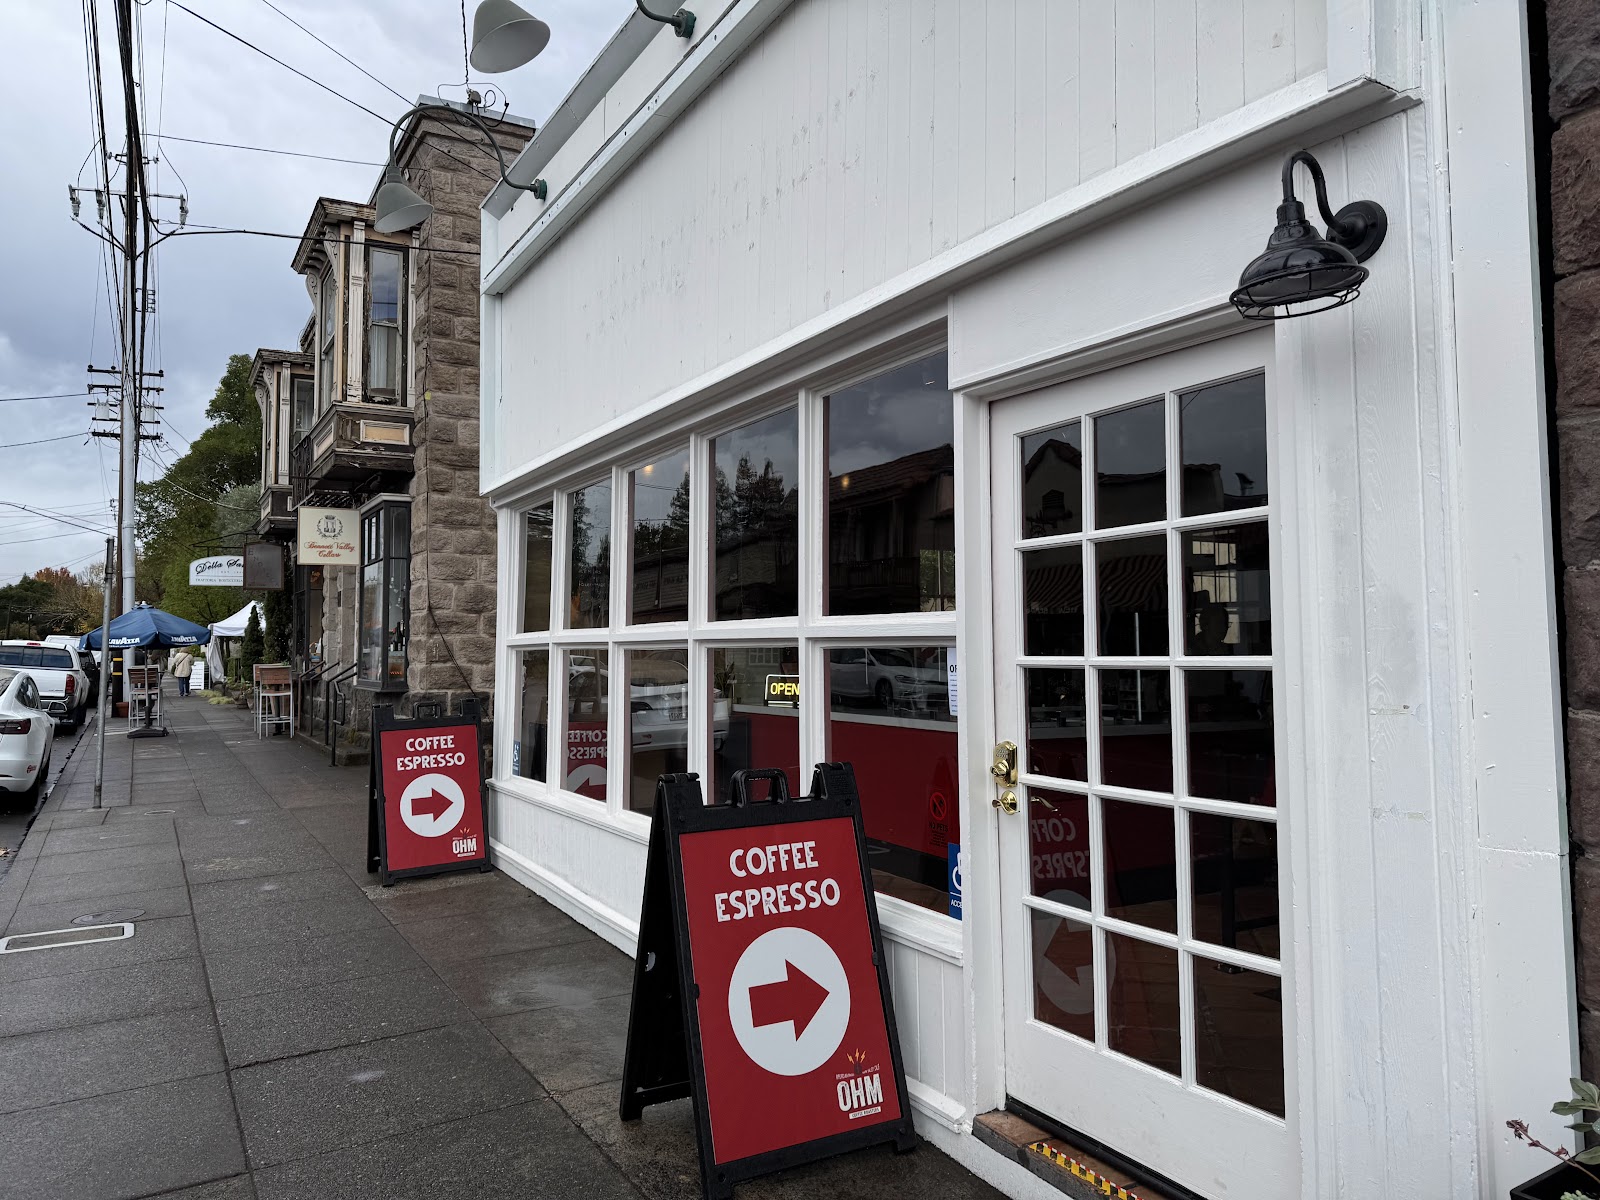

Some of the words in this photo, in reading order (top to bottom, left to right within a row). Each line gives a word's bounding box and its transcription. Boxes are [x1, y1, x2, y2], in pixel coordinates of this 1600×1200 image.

[304, 541, 333, 549] Bennett
[334, 542, 355, 552] Valley
[195, 561, 223, 574] Della
[770, 682, 799, 695] OPEN
[405, 735, 455, 752] COFFEE
[396, 752, 465, 771] ESPRESSO
[452, 838, 477, 854] OHM
[729, 841, 819, 878] COFFEE
[714, 878, 840, 922] ESPRESSO
[837, 1073, 883, 1111] OHM
